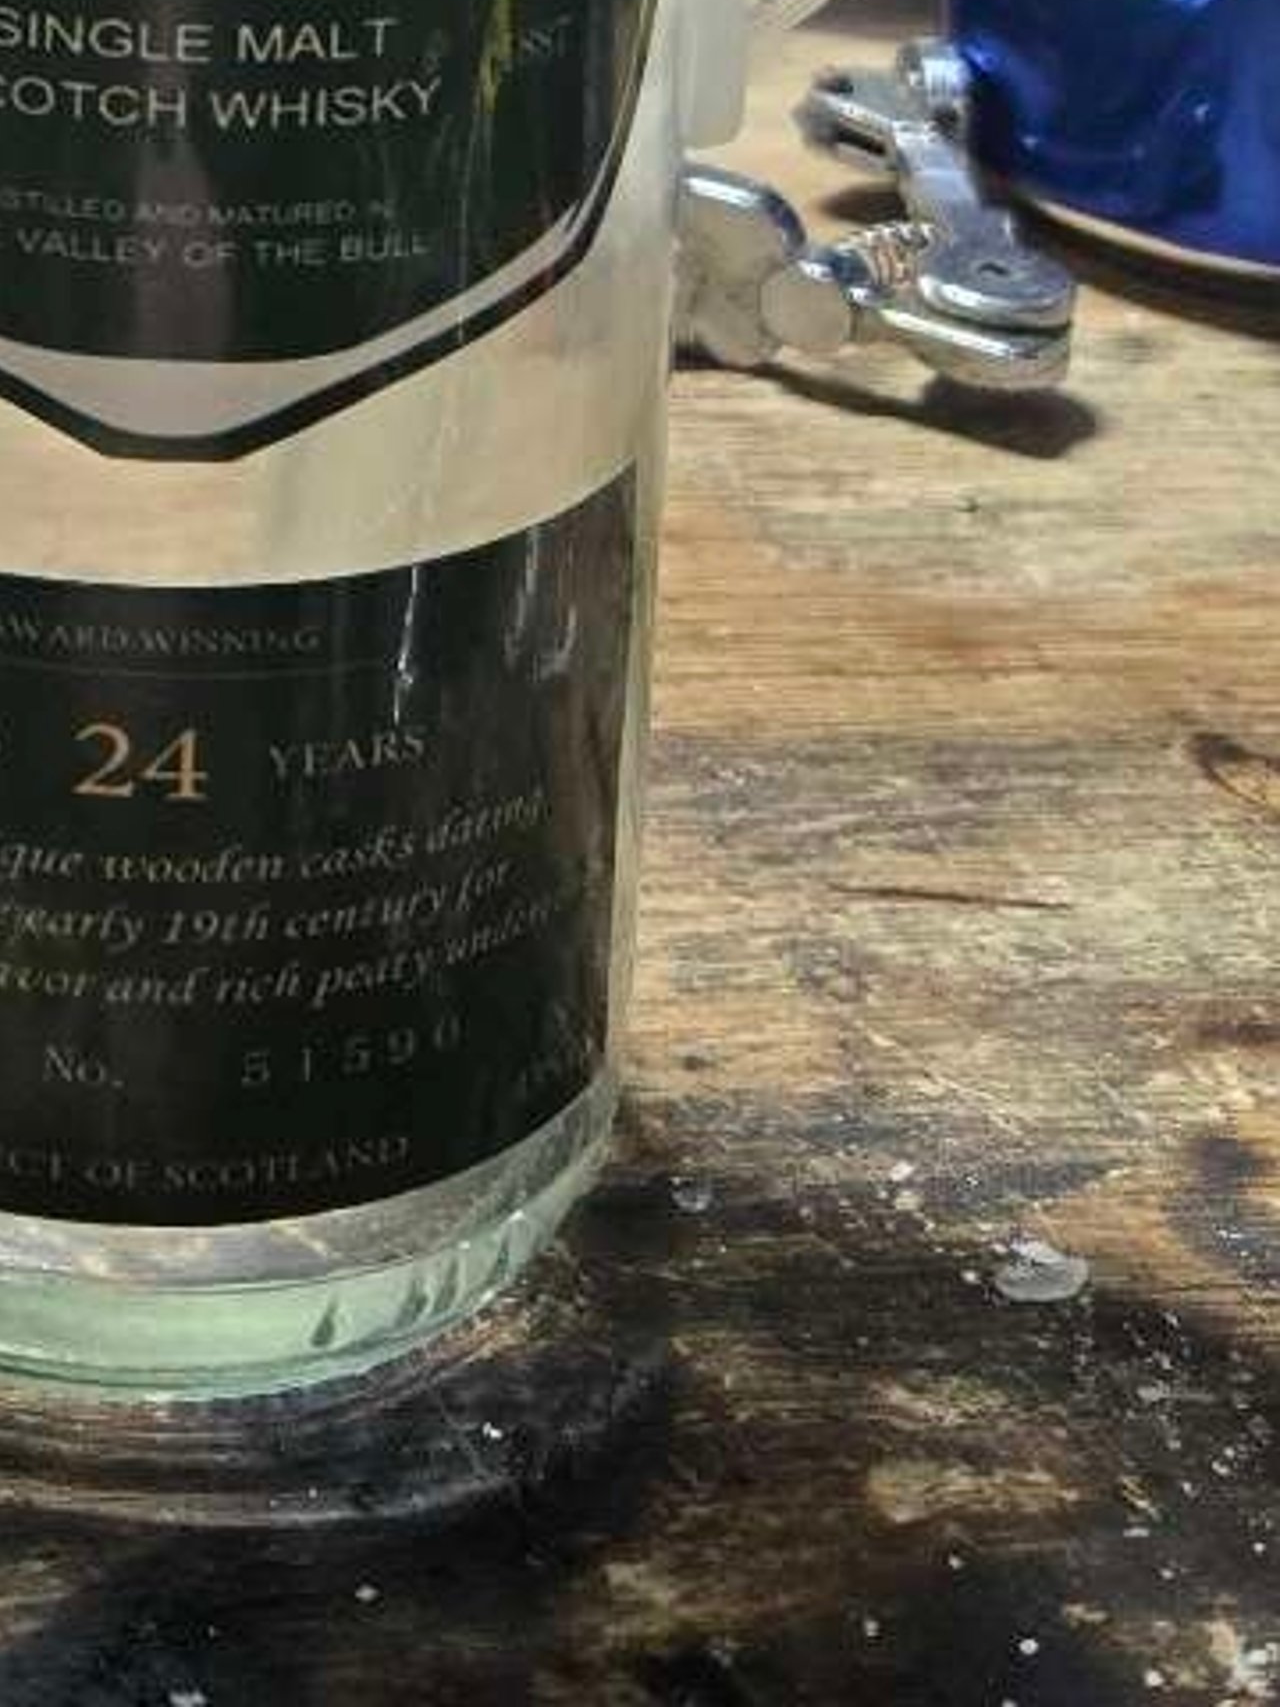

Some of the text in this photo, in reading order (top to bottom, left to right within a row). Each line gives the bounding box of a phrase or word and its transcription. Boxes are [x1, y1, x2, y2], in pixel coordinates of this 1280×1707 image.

[235, 15, 400, 66] MALT
[208, 75, 443, 131] WHISKY
[132, 198, 201, 225] AND
[14, 223, 167, 265] VALLEY
[183, 236, 241, 267] OF
[254, 236, 328, 266] THE
[339, 229, 431, 260] BULL
[71, 721, 209, 800] 24
[269, 729, 425, 779] YEARS
[99, 844, 284, 885] wooden
[300, 825, 416, 878] casks
[162, 906, 270, 945] 19th
[284, 884, 450, 941] century
[102, 965, 211, 1006] and
[214, 960, 301, 1005] rich
[83, 1153, 149, 1189] OF
[163, 1135, 411, 1190] SCOTLAND
